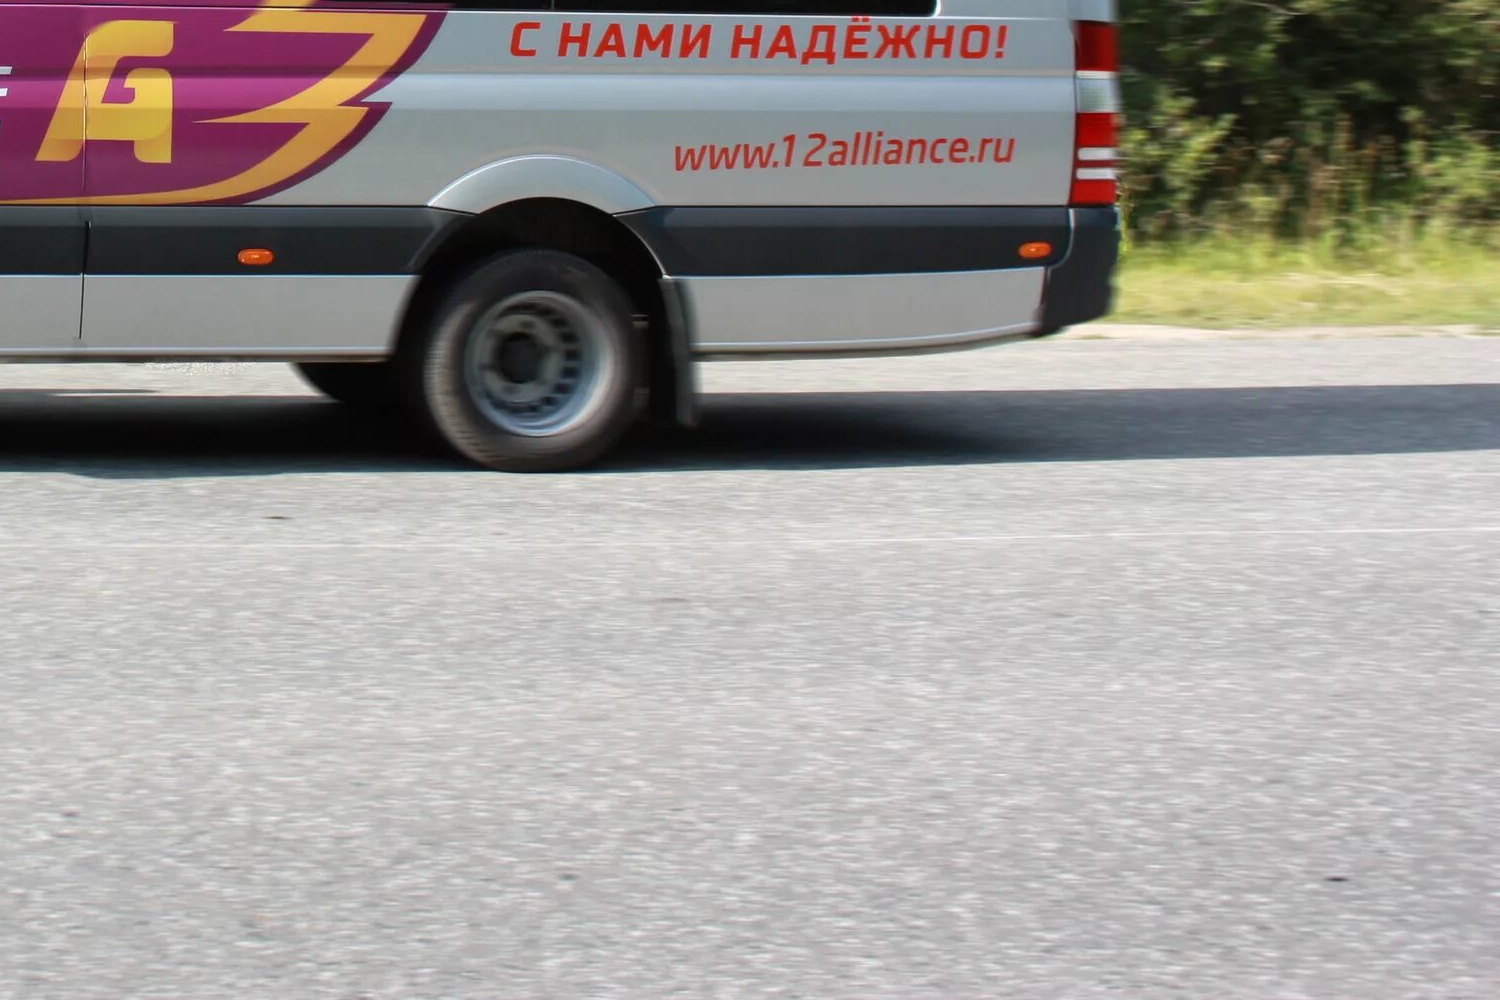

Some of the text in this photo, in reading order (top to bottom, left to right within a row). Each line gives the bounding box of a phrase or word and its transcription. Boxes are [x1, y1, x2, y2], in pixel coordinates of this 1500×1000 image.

[510, 15, 1009, 66] С НАМИ НАДЁЖНО!
[675, 132, 1017, 172] www.12alliance.ru
